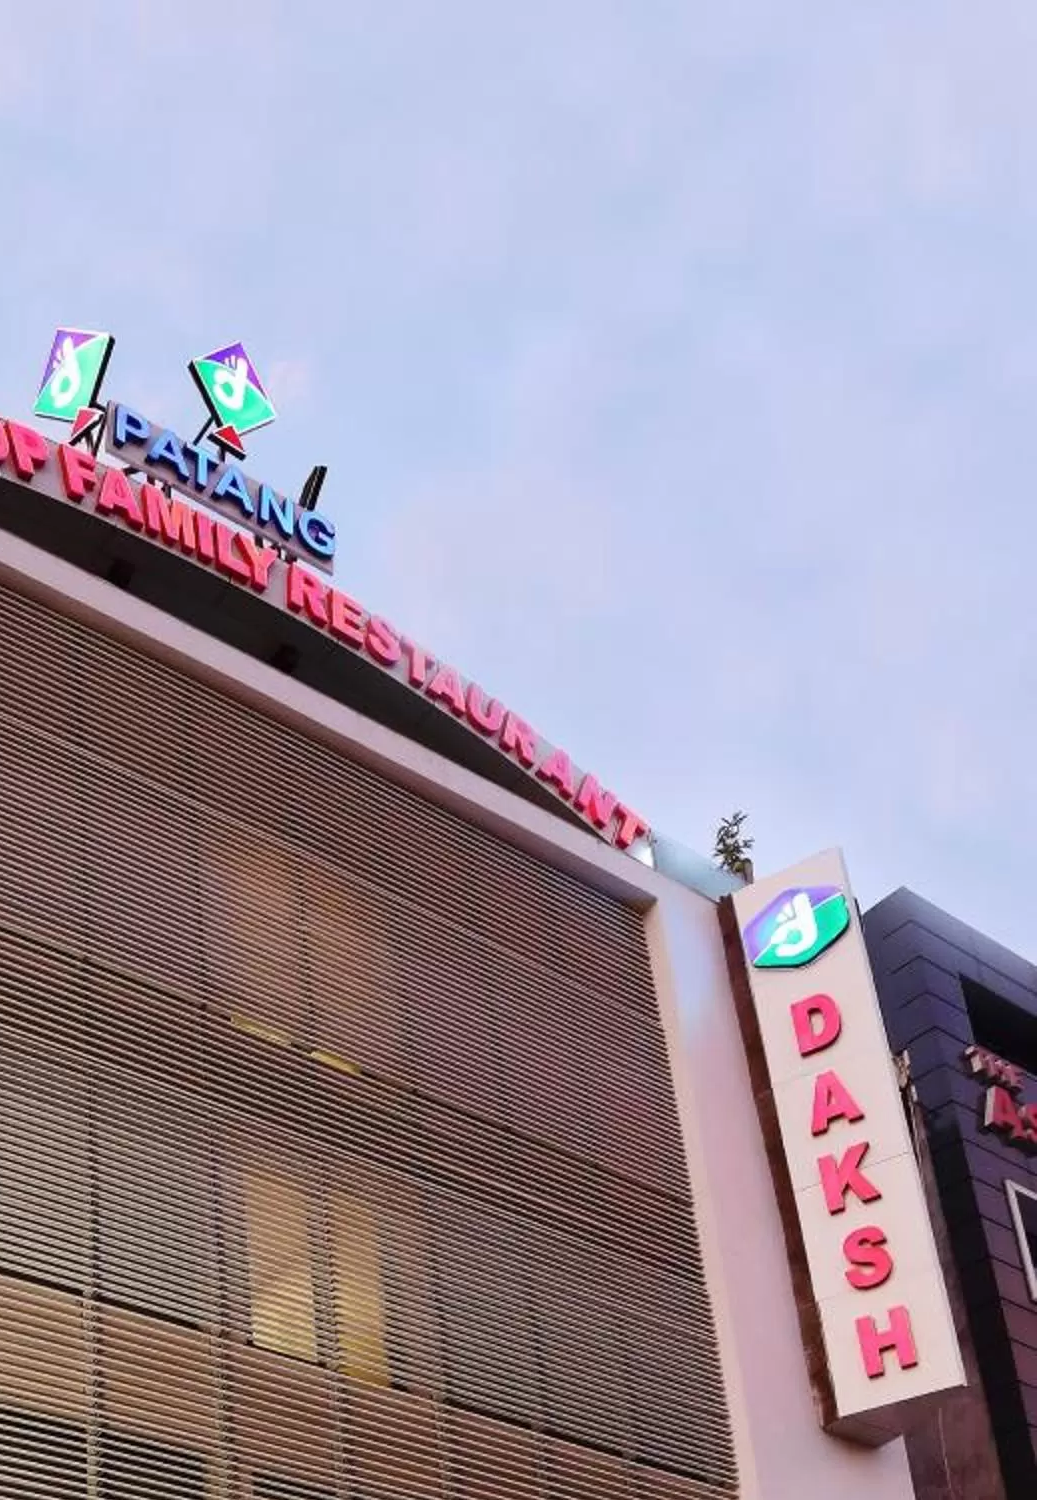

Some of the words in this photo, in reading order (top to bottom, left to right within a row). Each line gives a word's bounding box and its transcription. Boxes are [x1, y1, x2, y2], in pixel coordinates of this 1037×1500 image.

[58, 442, 277, 593] FAMILY
[286, 560, 647, 850] RESTAURANT
[113, 402, 337, 560] PATANG
[789, 992, 919, 1379] DAKSH
